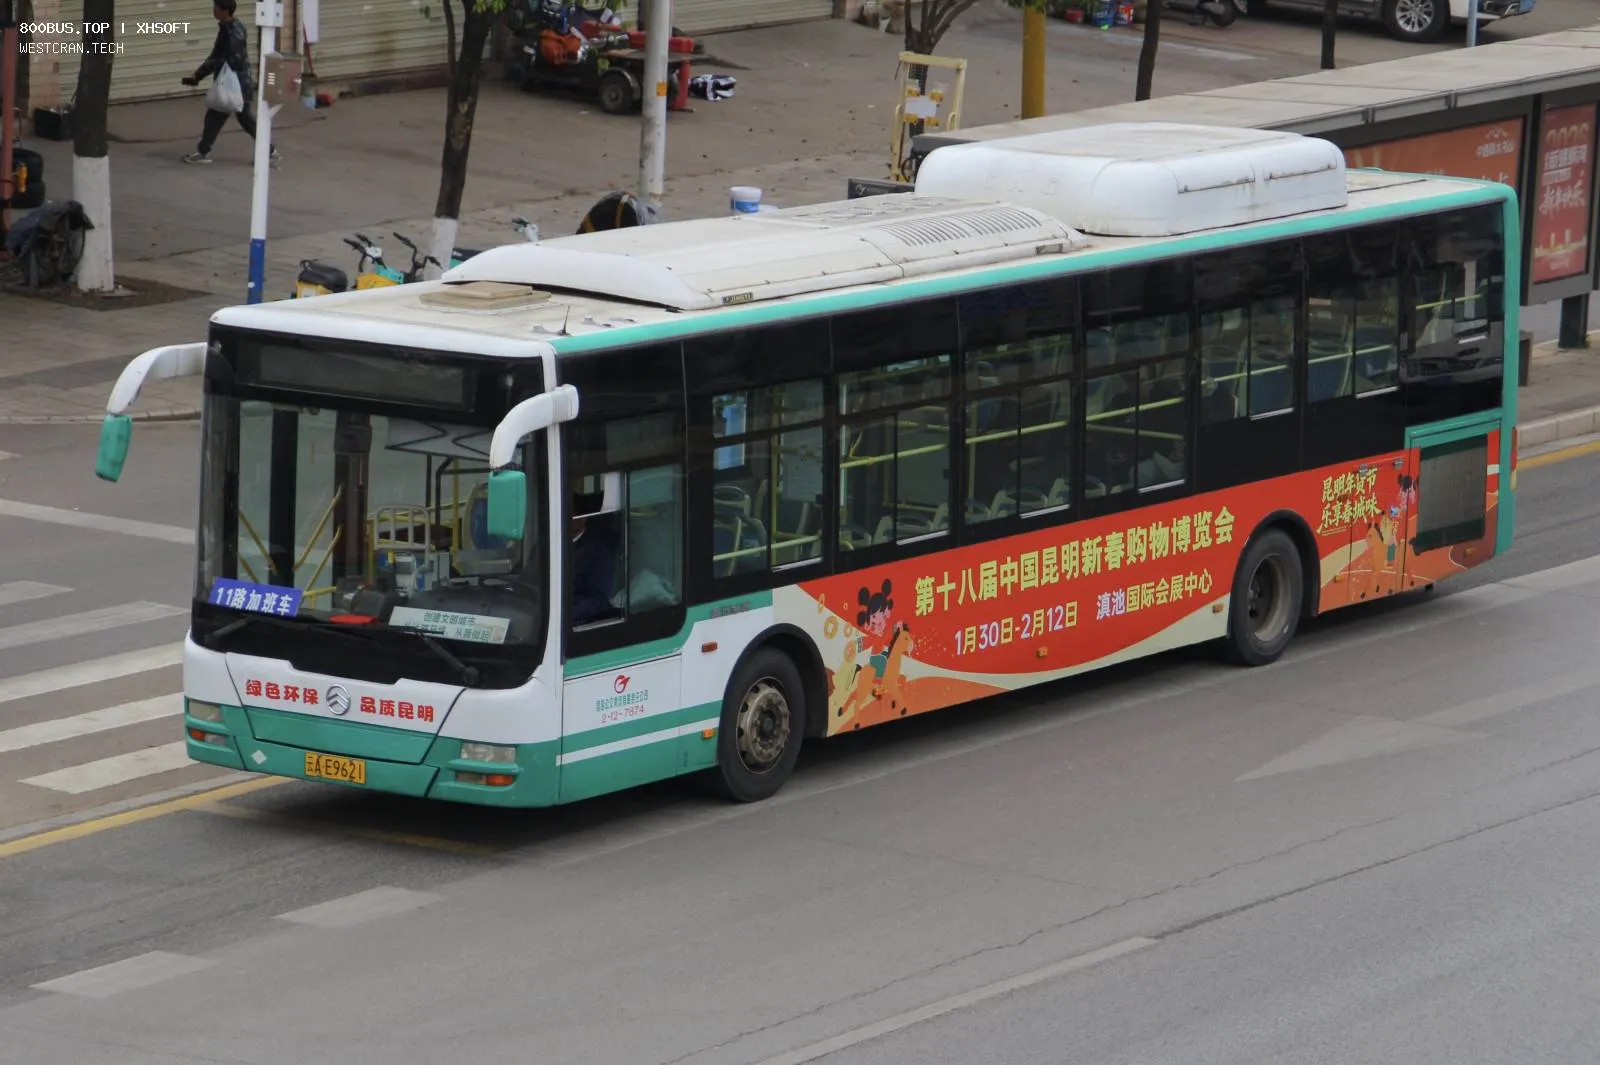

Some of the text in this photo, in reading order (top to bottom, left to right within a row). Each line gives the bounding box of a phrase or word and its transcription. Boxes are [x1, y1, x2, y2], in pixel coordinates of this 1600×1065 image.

[1321, 467, 1378, 503] 昆明年货节
[915, 506, 1236, 618] 第十八届中国昆明新春购物博览会
[215, 587, 293, 616] 11路加班车
[954, 568, 1212, 655] 1月30日-2月12日 滇池国际会展中心
[423, 611, 477, 627] 创建文明城市
[245, 679, 319, 704] 绿色环保
[360, 696, 434, 723] 品质昆明
